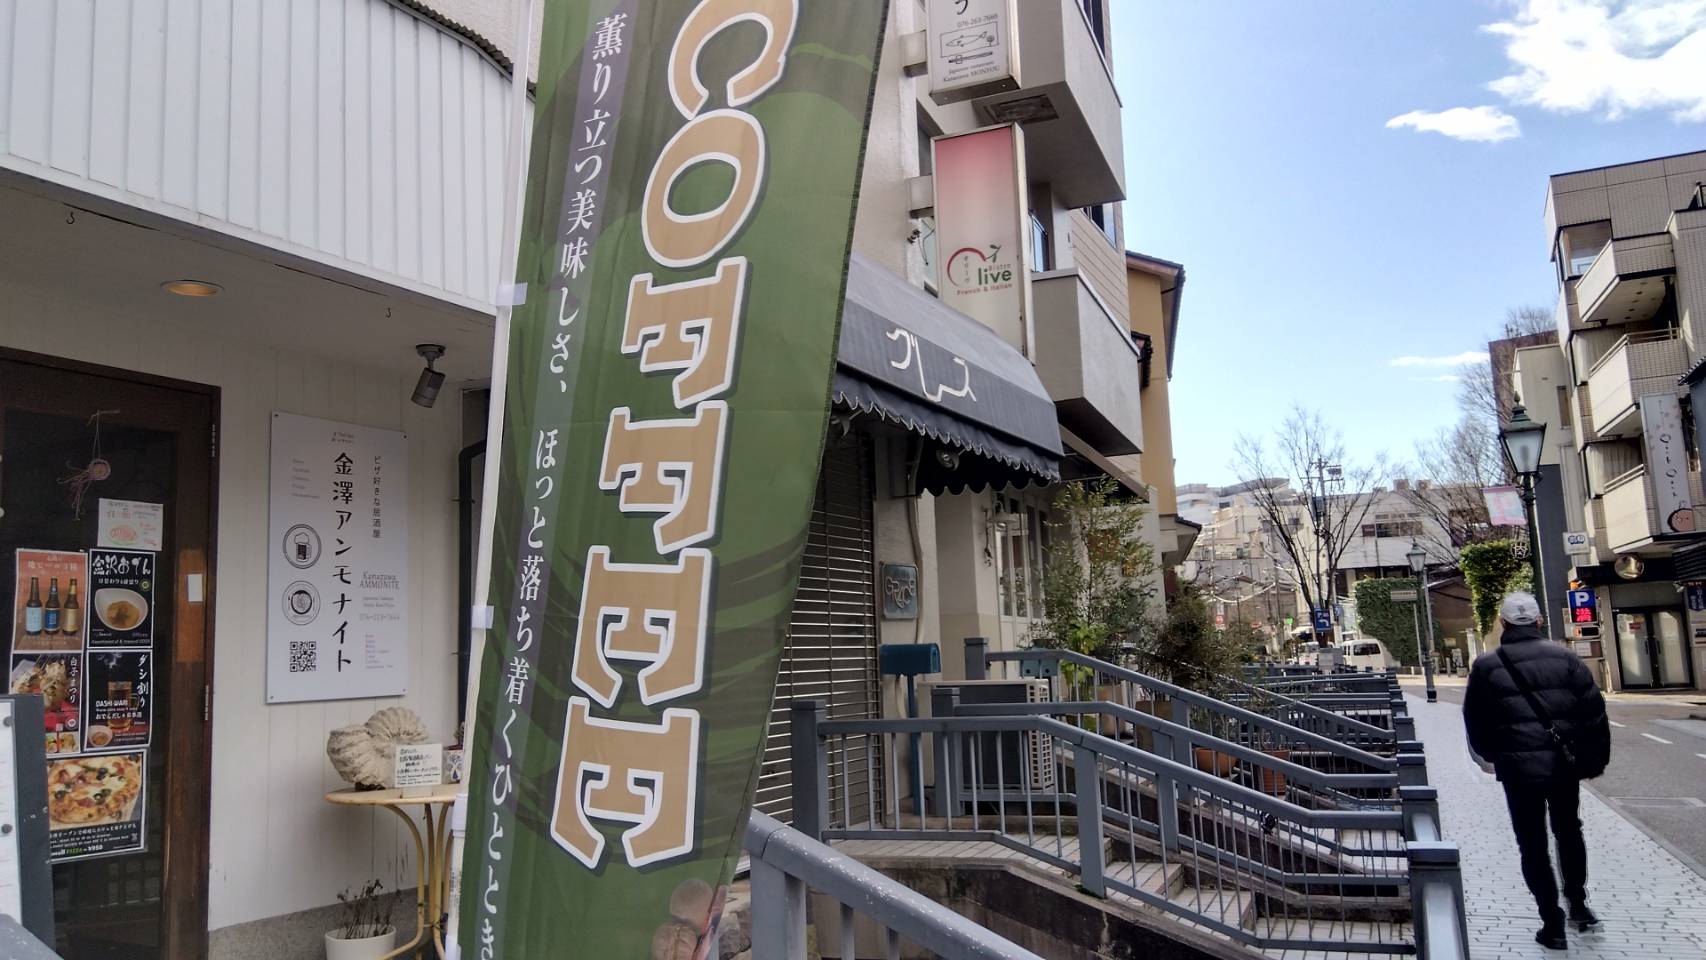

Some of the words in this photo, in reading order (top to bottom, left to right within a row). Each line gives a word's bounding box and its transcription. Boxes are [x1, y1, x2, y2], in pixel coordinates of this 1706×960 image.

[551, 0, 799, 869] COFFEE
[332, 452, 353, 673] 金澤アンモナイト
[1574, 592, 1590, 607] P
